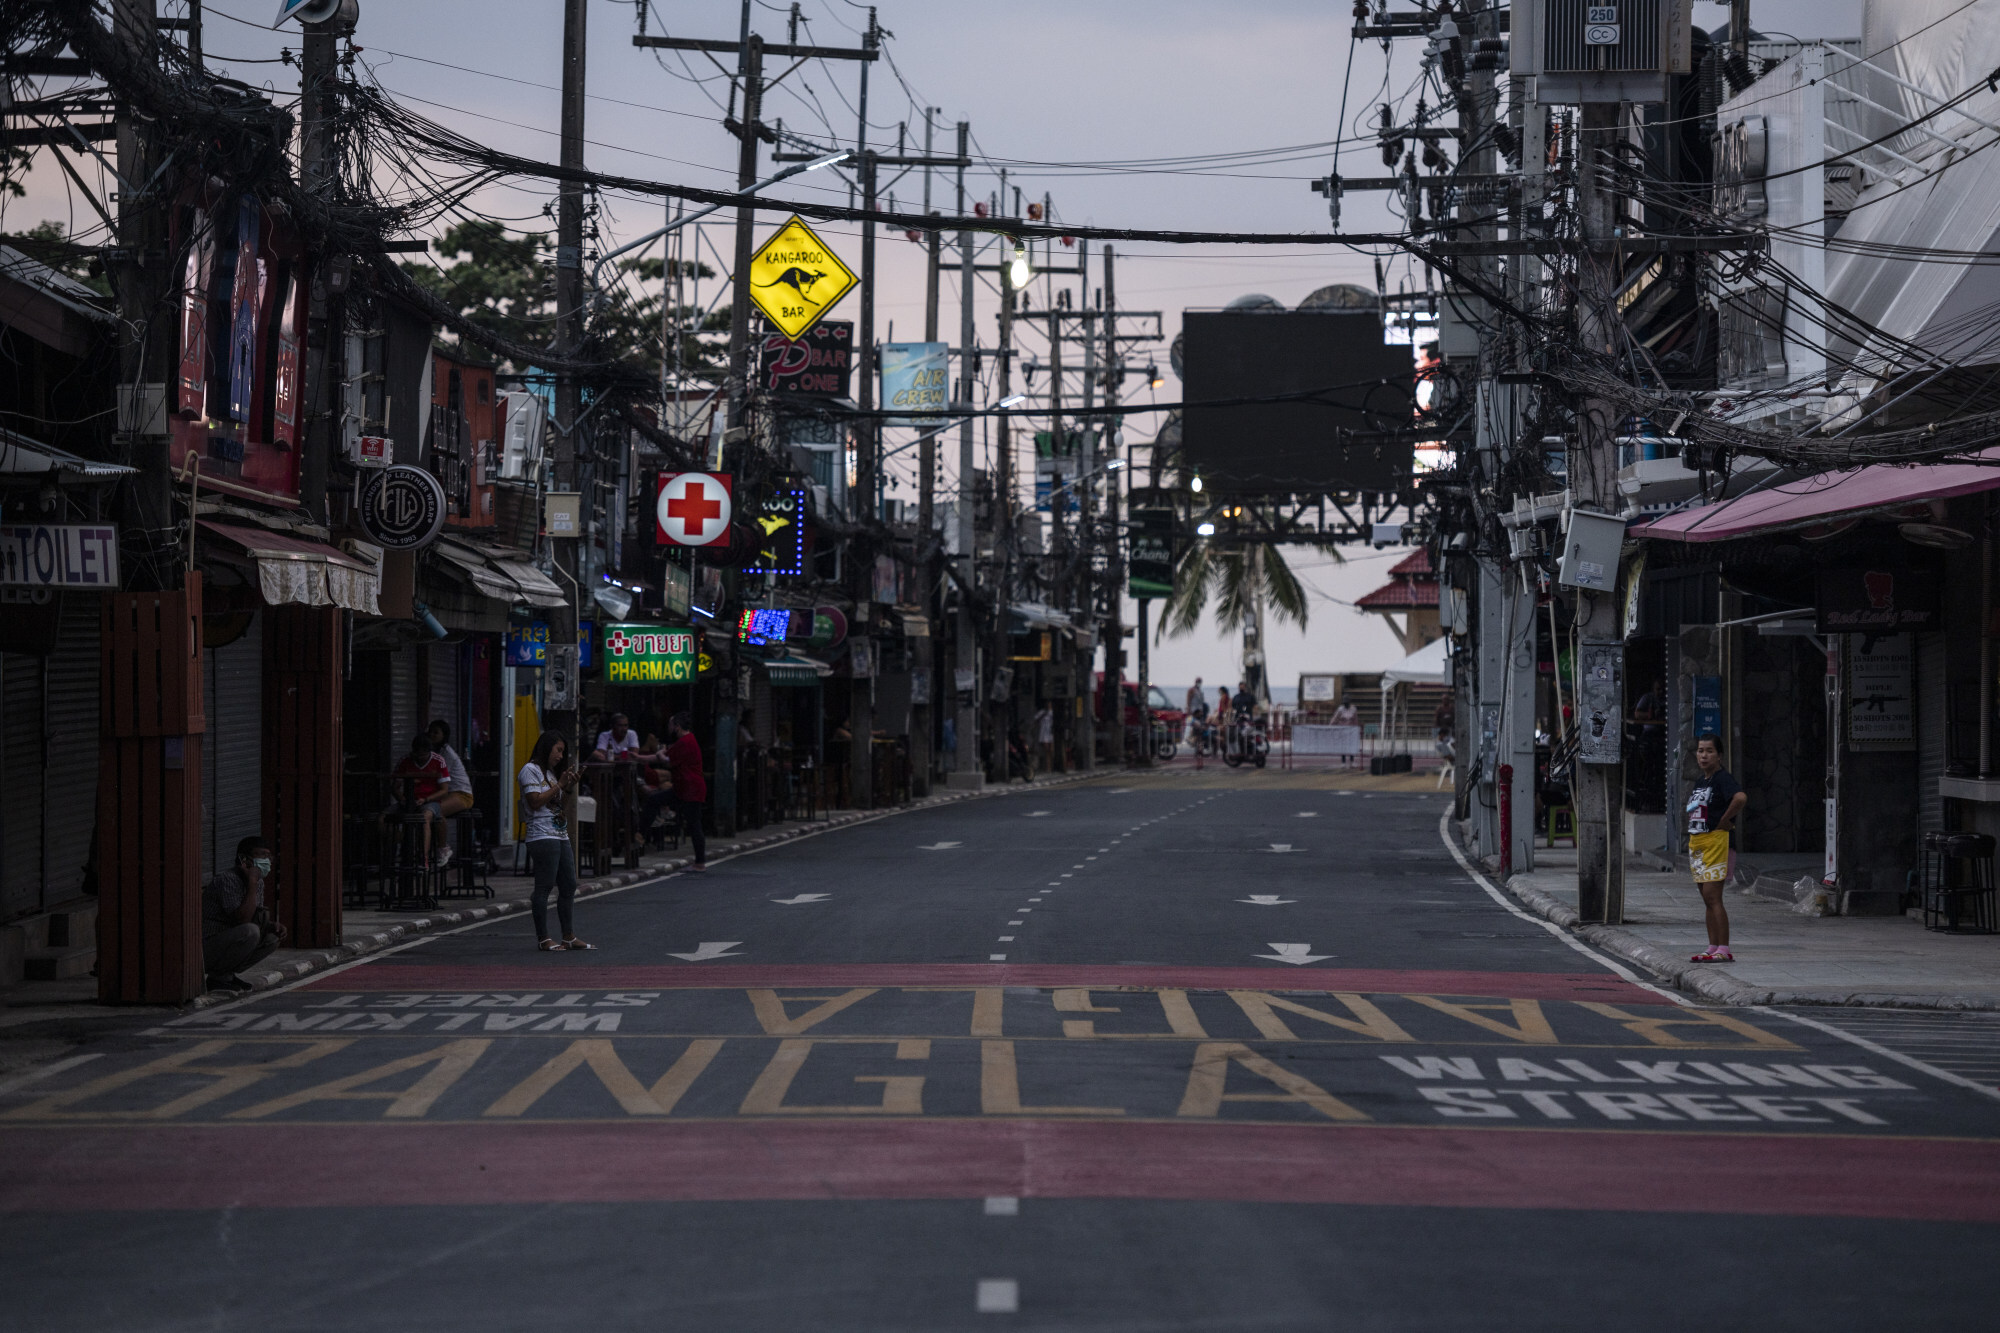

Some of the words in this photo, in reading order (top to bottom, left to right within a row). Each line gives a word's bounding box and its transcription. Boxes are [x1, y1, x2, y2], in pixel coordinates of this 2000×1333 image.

[1590, 9, 1614, 21] 250
[766, 252, 823, 264] KANGAROO
[782, 307, 805, 318] BAR
[811, 349, 847, 368] BAR
[800, 373, 840, 391] ONE
[913, 368, 946, 388] AIR
[893, 389, 945, 405] CREW
[395, 472, 428, 493] LEATHER
[426, 493, 434, 518] WEAR
[379, 533, 398, 544] Since
[400, 534, 417, 544] 1993
[15, 527, 112, 583] TOILET
[1131, 548, 1171, 564] Chang
[1858, 610, 1898, 628] Lady
[1900, 609, 1932, 623] Bar
[632, 634, 695, 655] ขายยา
[609, 660, 693, 681] PHARMACY
[303, 992, 661, 1008] STREET
[162, 1011, 623, 1031] WALKING
[0, 1038, 1374, 1120] BANGLA
[1380, 1055, 1917, 1090] WALKING
[1420, 1087, 1888, 1124] STREET
